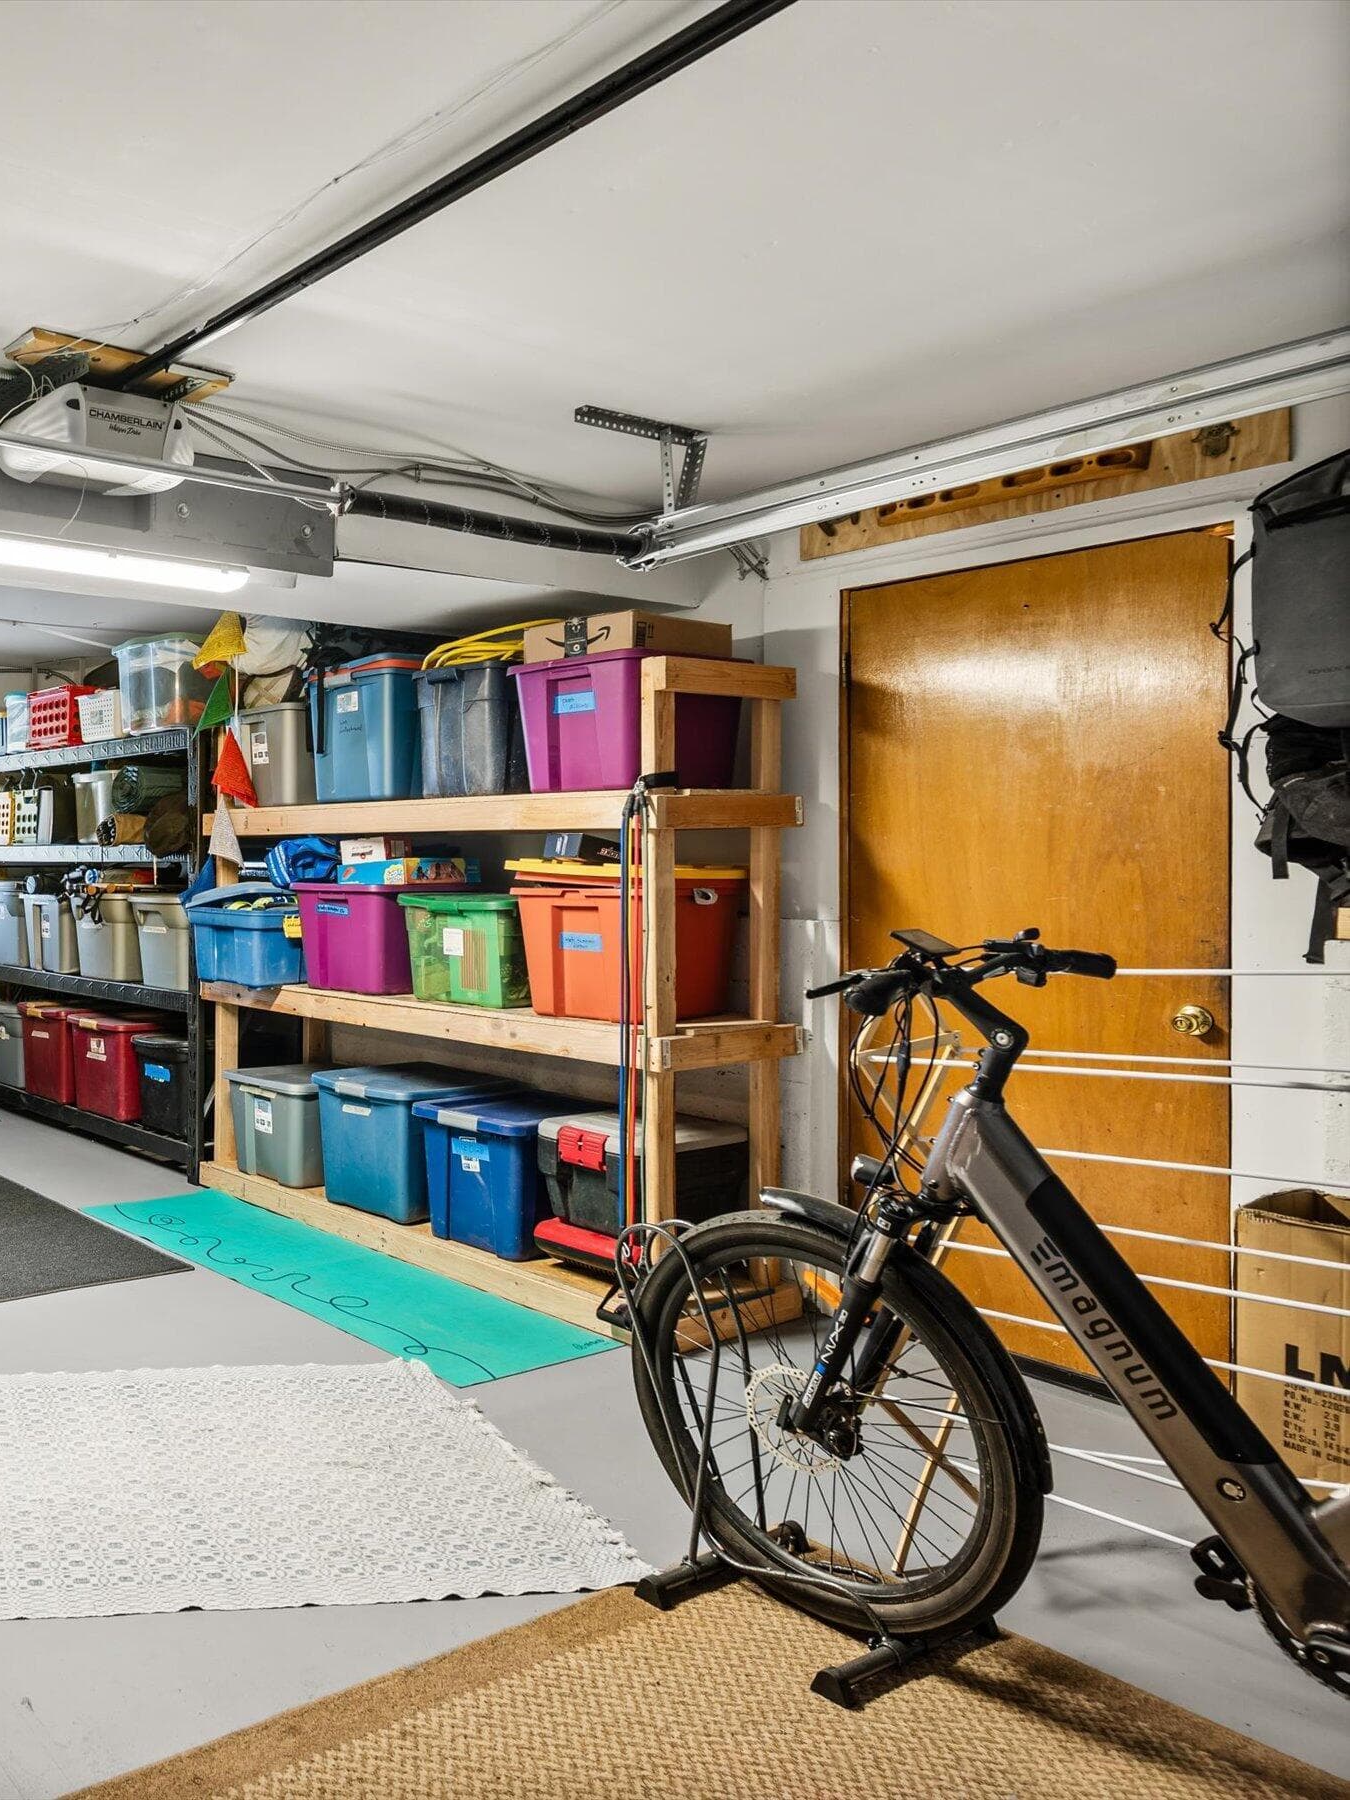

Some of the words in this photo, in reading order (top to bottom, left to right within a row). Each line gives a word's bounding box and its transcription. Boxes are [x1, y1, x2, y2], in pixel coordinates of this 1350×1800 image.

[89, 408, 163, 431] CHAMBERLAIN
[1284, 1441, 1307, 1454] MADE
[1312, 1449, 1321, 1458] IN
[1327, 1453, 1350, 1466] CHIN
